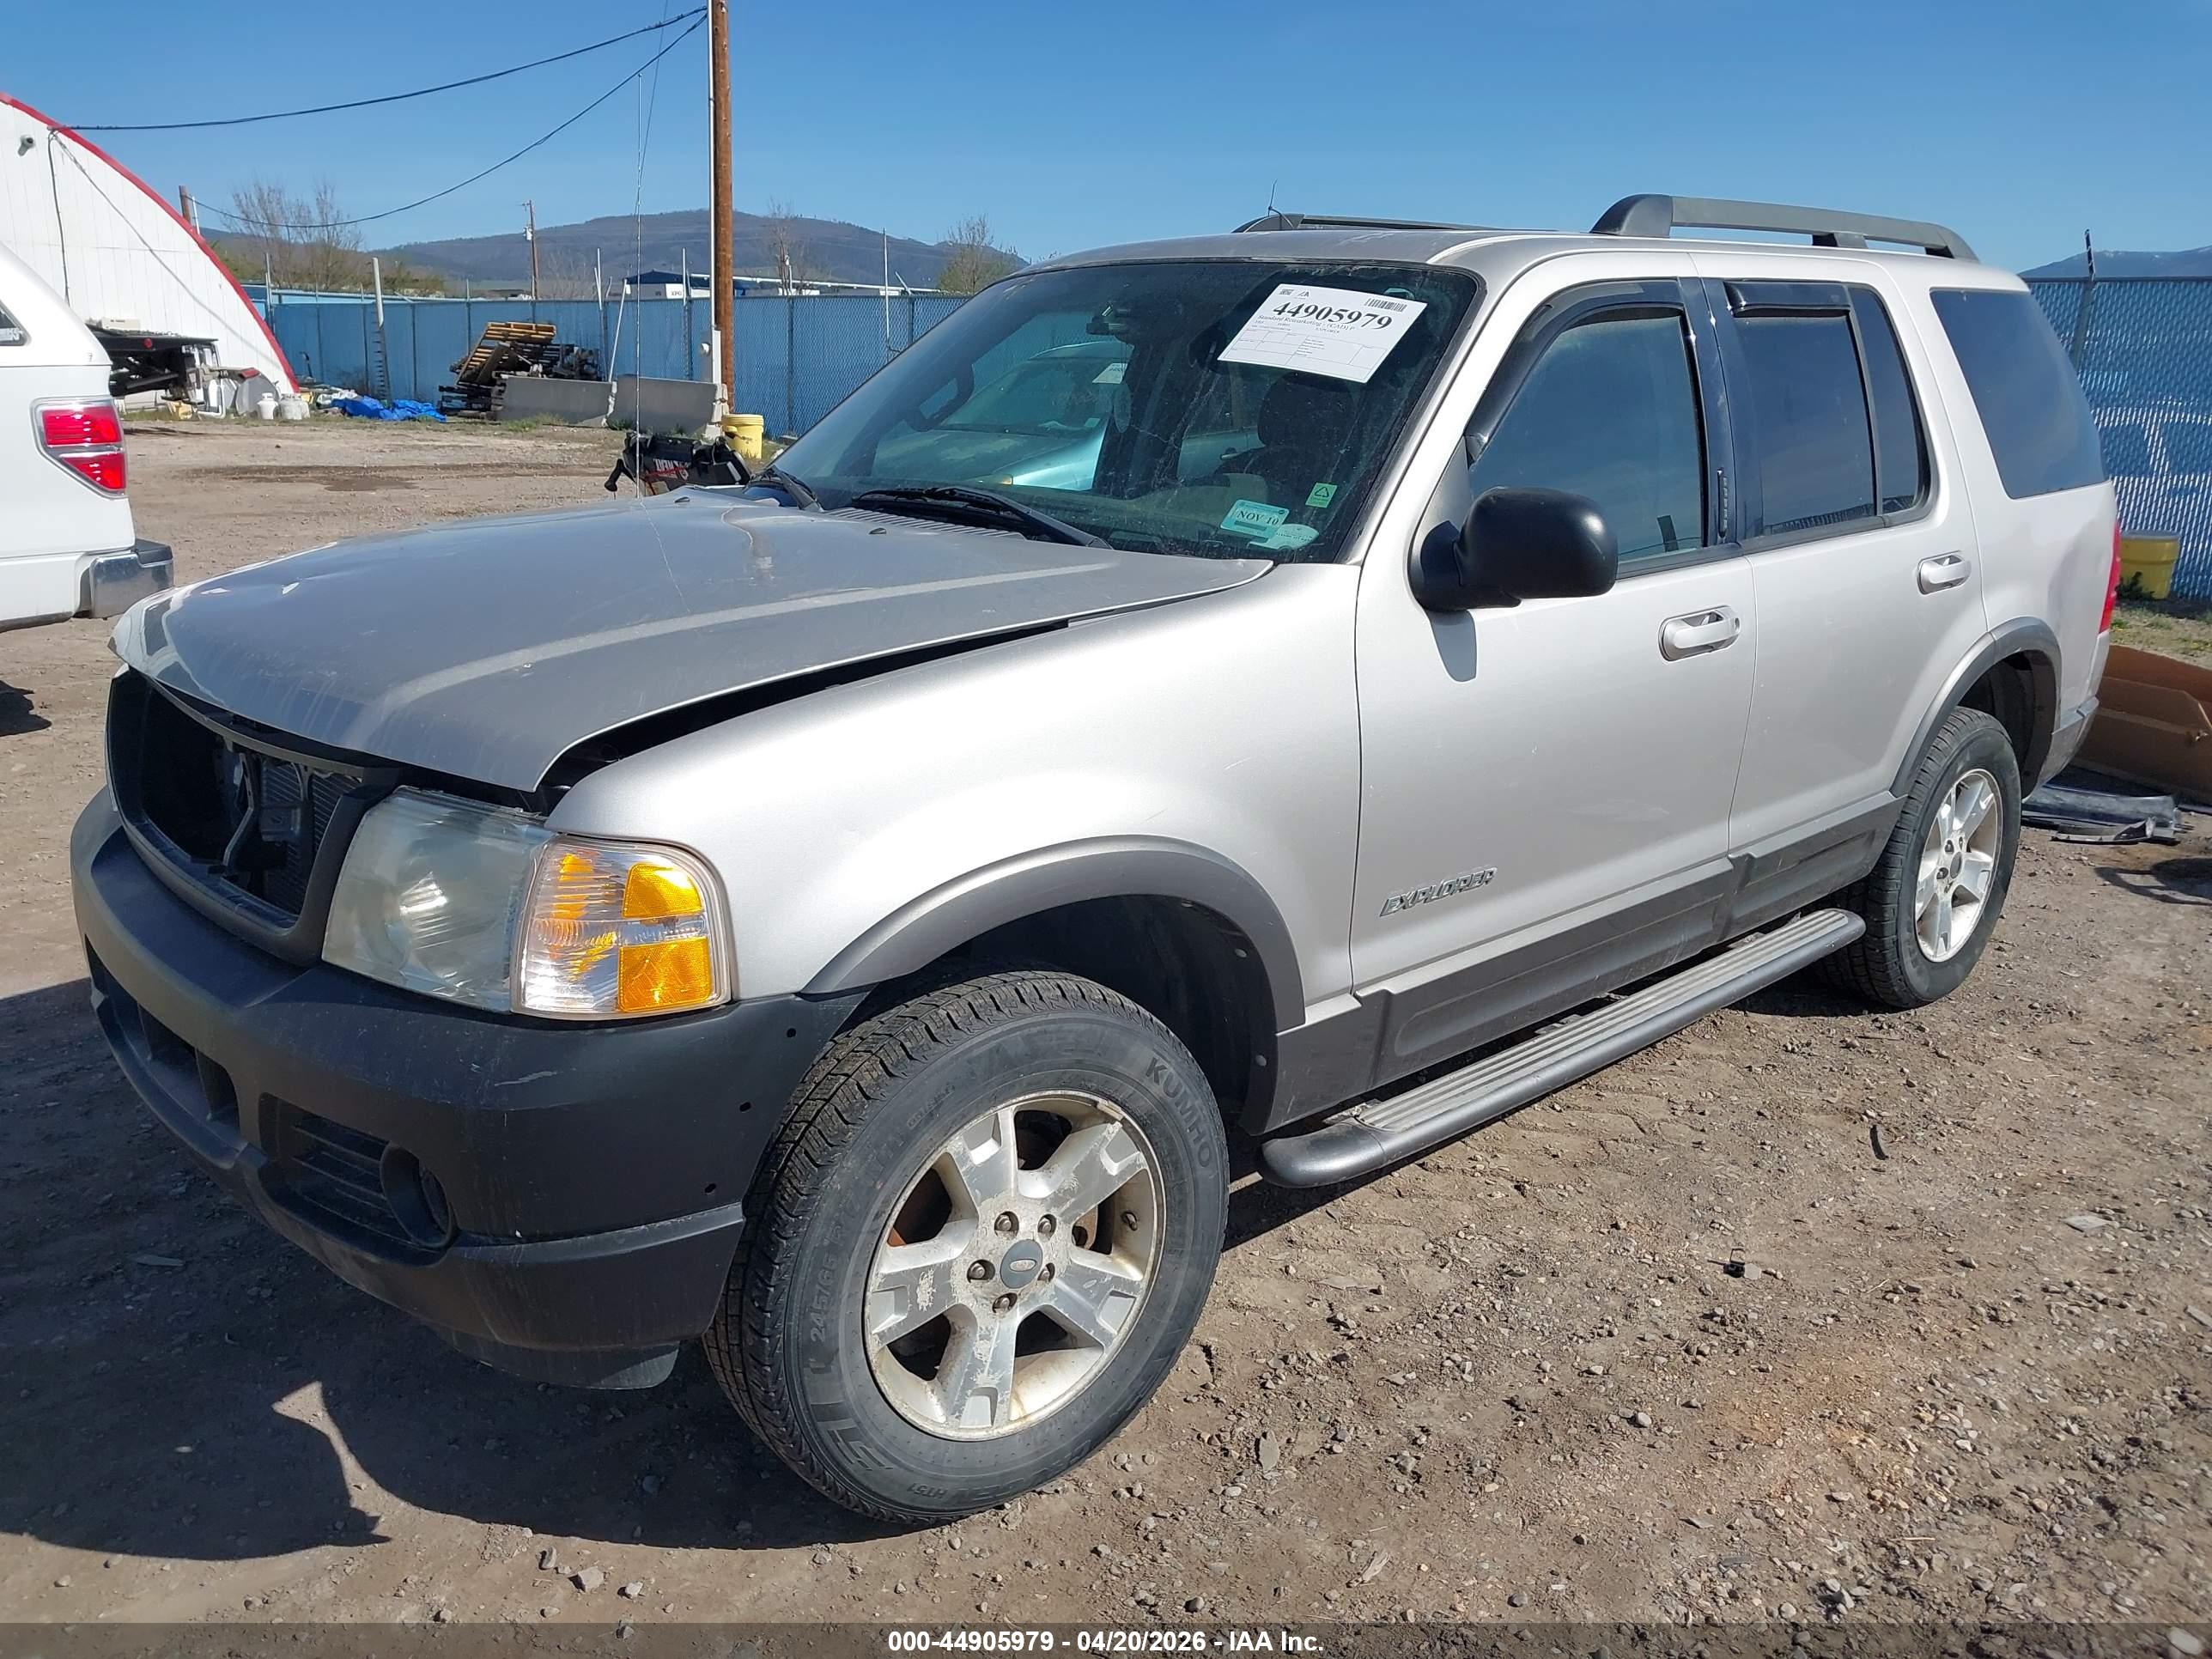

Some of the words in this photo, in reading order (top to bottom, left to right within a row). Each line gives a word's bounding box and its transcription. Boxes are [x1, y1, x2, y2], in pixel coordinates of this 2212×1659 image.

[1273, 301, 1393, 330] 44905979
[1284, 317, 1322, 327] Remarketing
[1237, 510, 1265, 522] NOV
[1379, 866, 1498, 917] EXPLORER
[1145, 1057, 1212, 1168] KUMHO
[908, 1484, 945, 1500] HT51
